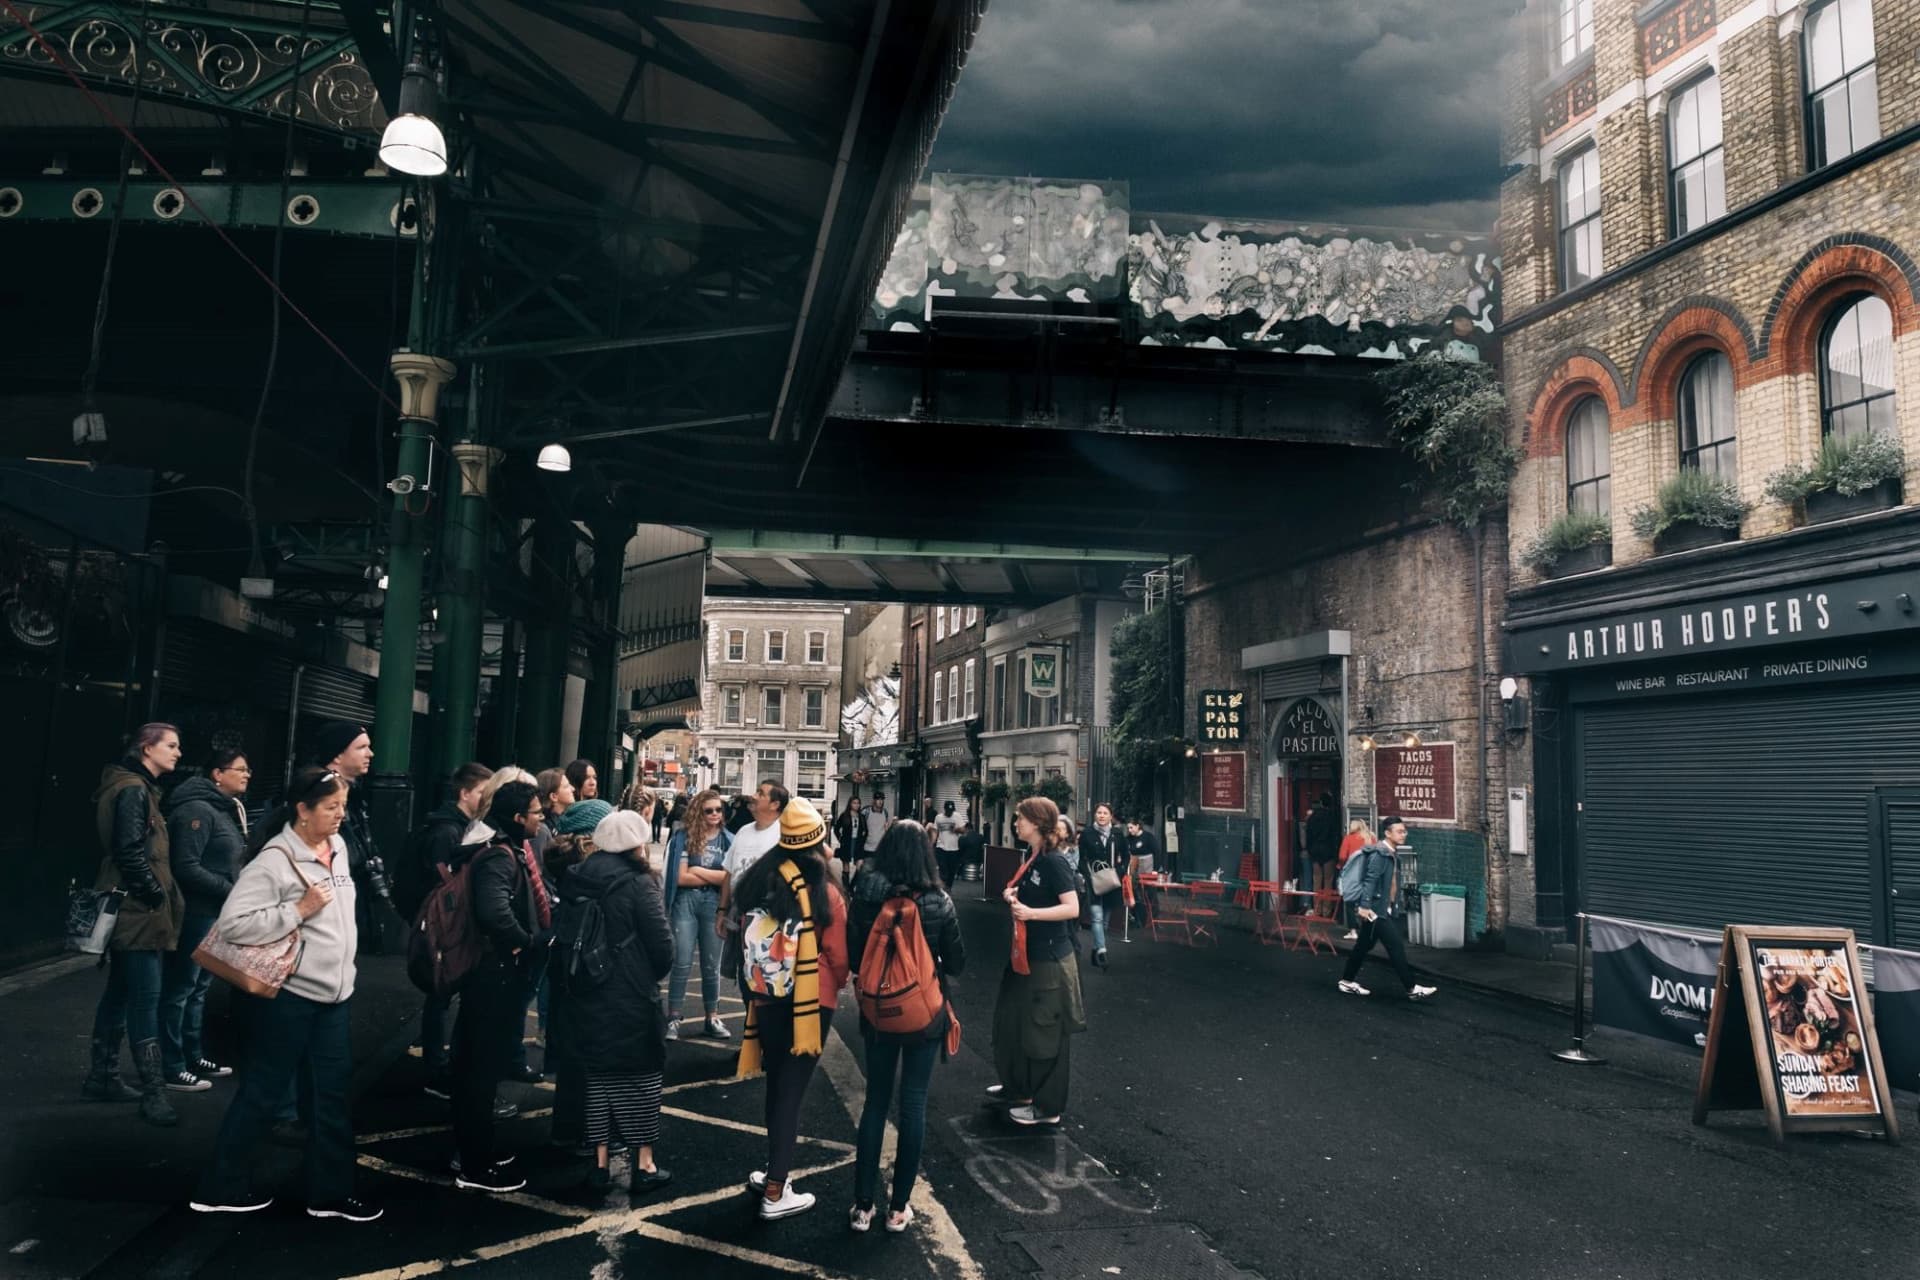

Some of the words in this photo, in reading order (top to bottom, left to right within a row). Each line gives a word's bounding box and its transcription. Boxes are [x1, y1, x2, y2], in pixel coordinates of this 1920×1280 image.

[1568, 619, 1664, 660] ARTHUR
[1681, 594, 1830, 646] HOOPER'S
[1032, 660, 1055, 680] W
[1616, 678, 1642, 691] WINE
[1644, 676, 1666, 689] BAR
[1676, 667, 1749, 685] RESTAURANT
[1763, 661, 1813, 677] PRIVATE
[1817, 656, 1868, 673] DINING
[1206, 695, 1227, 706] EL
[1206, 711, 1239, 723] PAS
[1303, 720, 1316, 734] EL
[1282, 735, 1337, 752] PASTOR
[1400, 750, 1432, 763] TACOS
[1397, 764, 1434, 776] TOSTADAS
[1399, 799, 1434, 811] MEZCAL
[1650, 975, 1706, 1011] DOOM
[1778, 1055, 1822, 1072] SUNDAY
[1781, 1075, 1828, 1093] SHARING
[1828, 1075, 1859, 1093] FEAST
